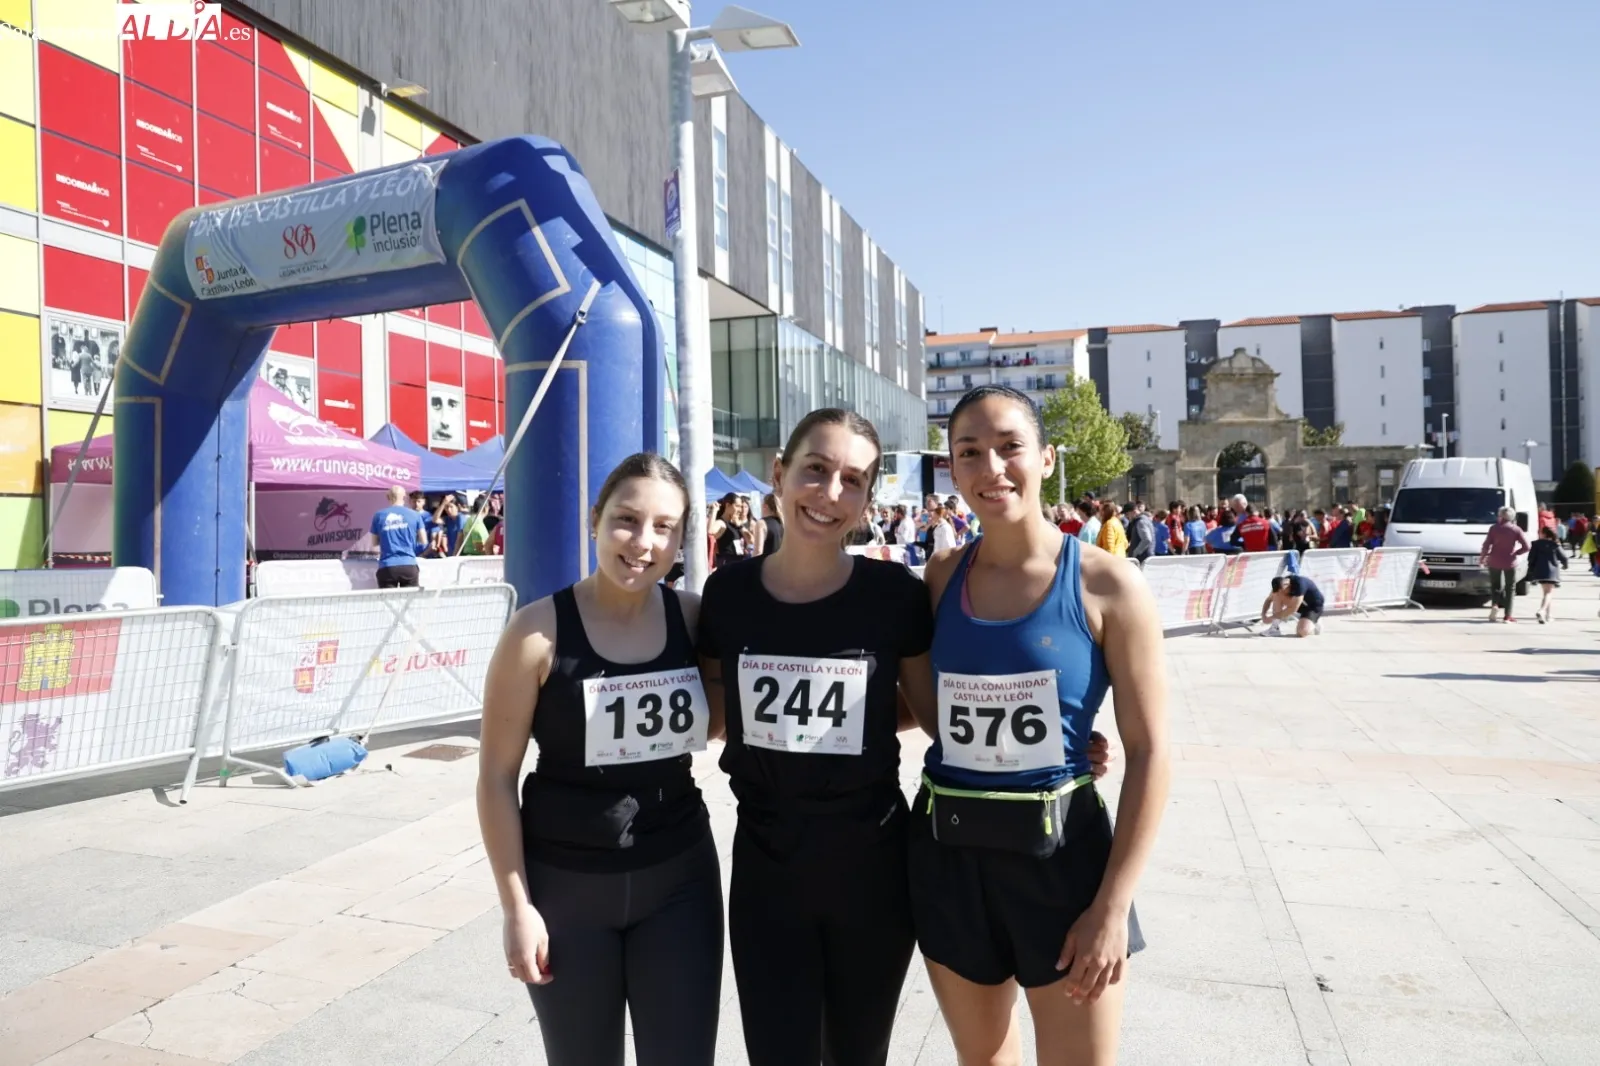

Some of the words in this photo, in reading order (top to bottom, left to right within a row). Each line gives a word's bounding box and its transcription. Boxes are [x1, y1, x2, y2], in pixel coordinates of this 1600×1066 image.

[256, 187, 347, 223] CASTILLA
[353, 182, 369, 202] Y
[370, 211, 422, 236] Plena
[216, 267, 239, 281] Junta
[200, 283, 228, 297] Castilla
[235, 276, 256, 291] León
[270, 457, 412, 481] www.runvasport.es
[742, 660, 759, 670] DÍA
[761, 662, 774, 671] DE
[777, 663, 823, 674] CASTILLA
[826, 666, 832, 675] Y
[609, 682, 623, 693] DE
[625, 678, 670, 691] CASTILLA
[670, 676, 676, 685] Y
[676, 673, 698, 685] LEÓN
[943, 677, 955, 688] DÍA
[969, 682, 980, 690] LA
[981, 678, 1049, 691] COMUNIDAD
[753, 676, 847, 728] 244
[953, 692, 994, 703] CASTILLA
[995, 694, 1001, 703] Y
[1003, 691, 1034, 703] LEÓN
[605, 688, 694, 740] 138
[949, 704, 1048, 747] 576
